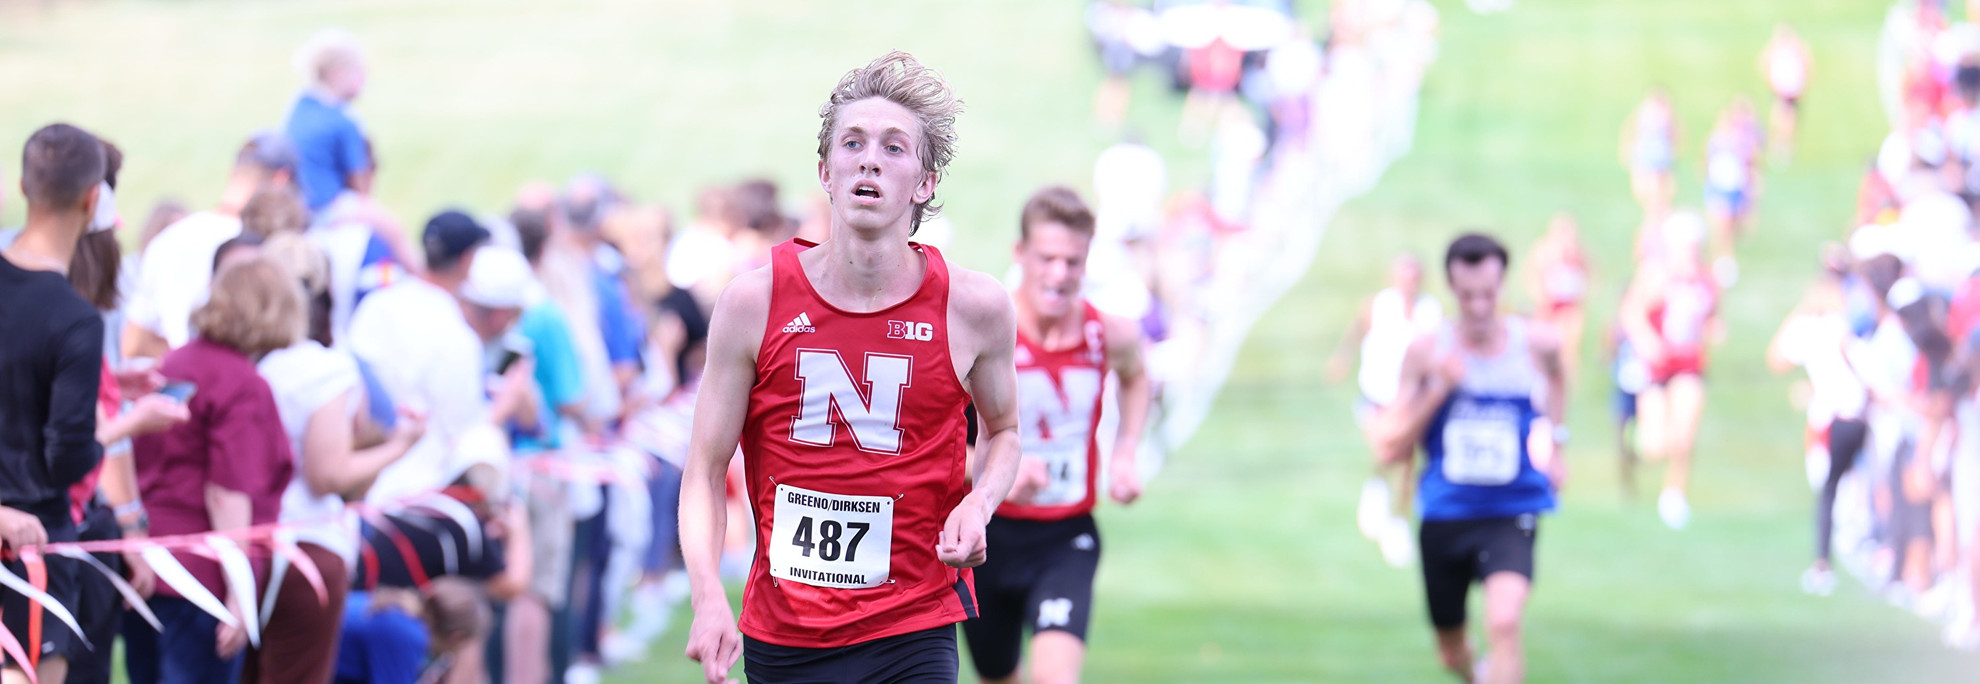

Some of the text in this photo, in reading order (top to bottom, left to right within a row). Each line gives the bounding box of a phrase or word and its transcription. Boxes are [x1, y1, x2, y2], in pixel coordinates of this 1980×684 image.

[782, 325, 816, 333] adidas
[788, 347, 914, 456] N
[787, 491, 880, 513] GREENO/DIRKSEN
[792, 515, 870, 562] 487
[789, 566, 867, 585] INVITATIONAL
